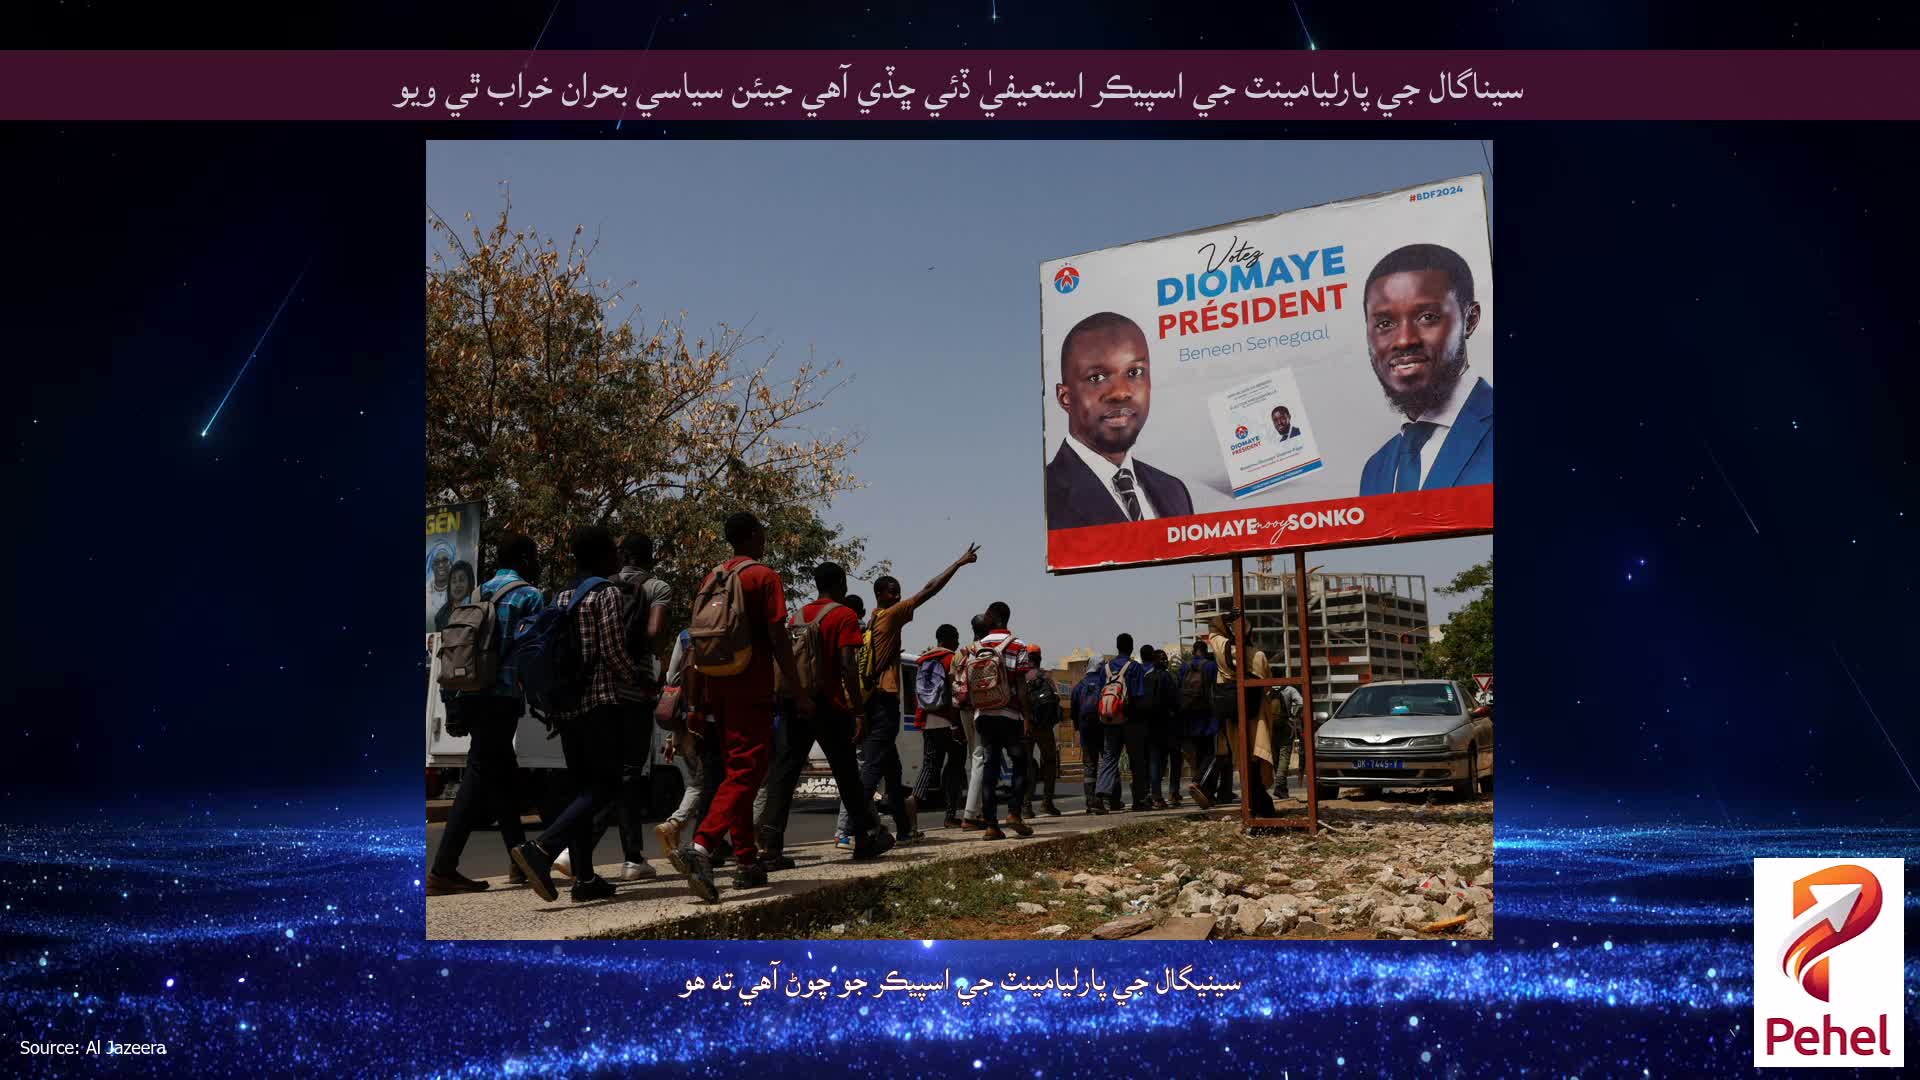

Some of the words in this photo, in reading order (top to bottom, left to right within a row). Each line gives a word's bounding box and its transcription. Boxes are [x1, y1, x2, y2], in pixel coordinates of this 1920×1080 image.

[1409, 185, 1464, 202] #BDF2024
[1198, 236, 1264, 274] Votez
[1157, 245, 1346, 307] DIOMAYE
[1158, 283, 1348, 340] PRÉSIDENT
[1179, 341, 1242, 362] Beneen
[1246, 324, 1330, 351] Senegaal
[1167, 517, 1258, 543] DIOMAYE
[1287, 507, 1365, 531] SONKO
